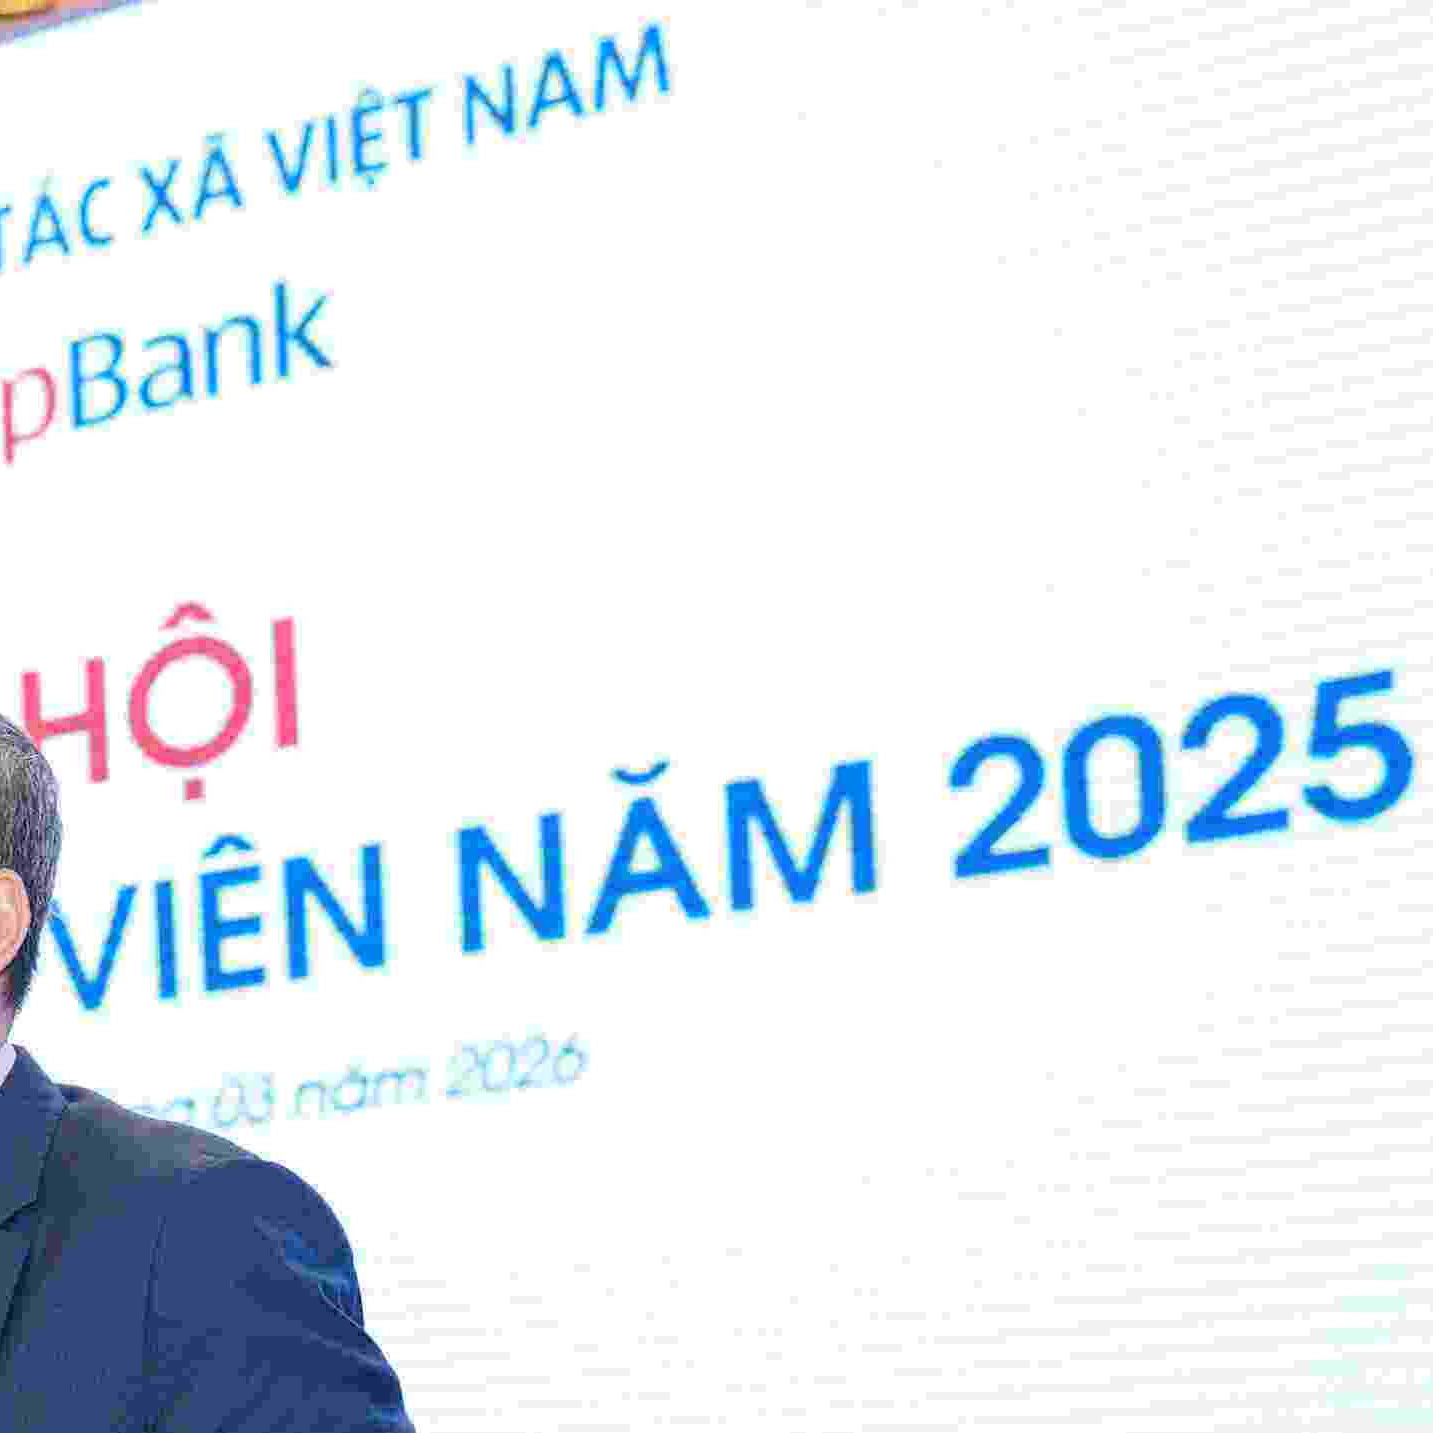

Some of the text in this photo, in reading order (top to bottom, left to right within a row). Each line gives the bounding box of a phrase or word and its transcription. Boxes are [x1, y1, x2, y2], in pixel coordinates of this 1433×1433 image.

[137, 131, 246, 238] XÃ
[261, 84, 434, 194] VIỆT
[462, 21, 672, 147] NAM
[21, 600, 300, 801] HỘI
[42, 831, 391, 1014] VIÊN
[453, 758, 879, 955] NĂM
[945, 667, 1418, 880] 2025
[444, 1030, 589, 1101] 2026
